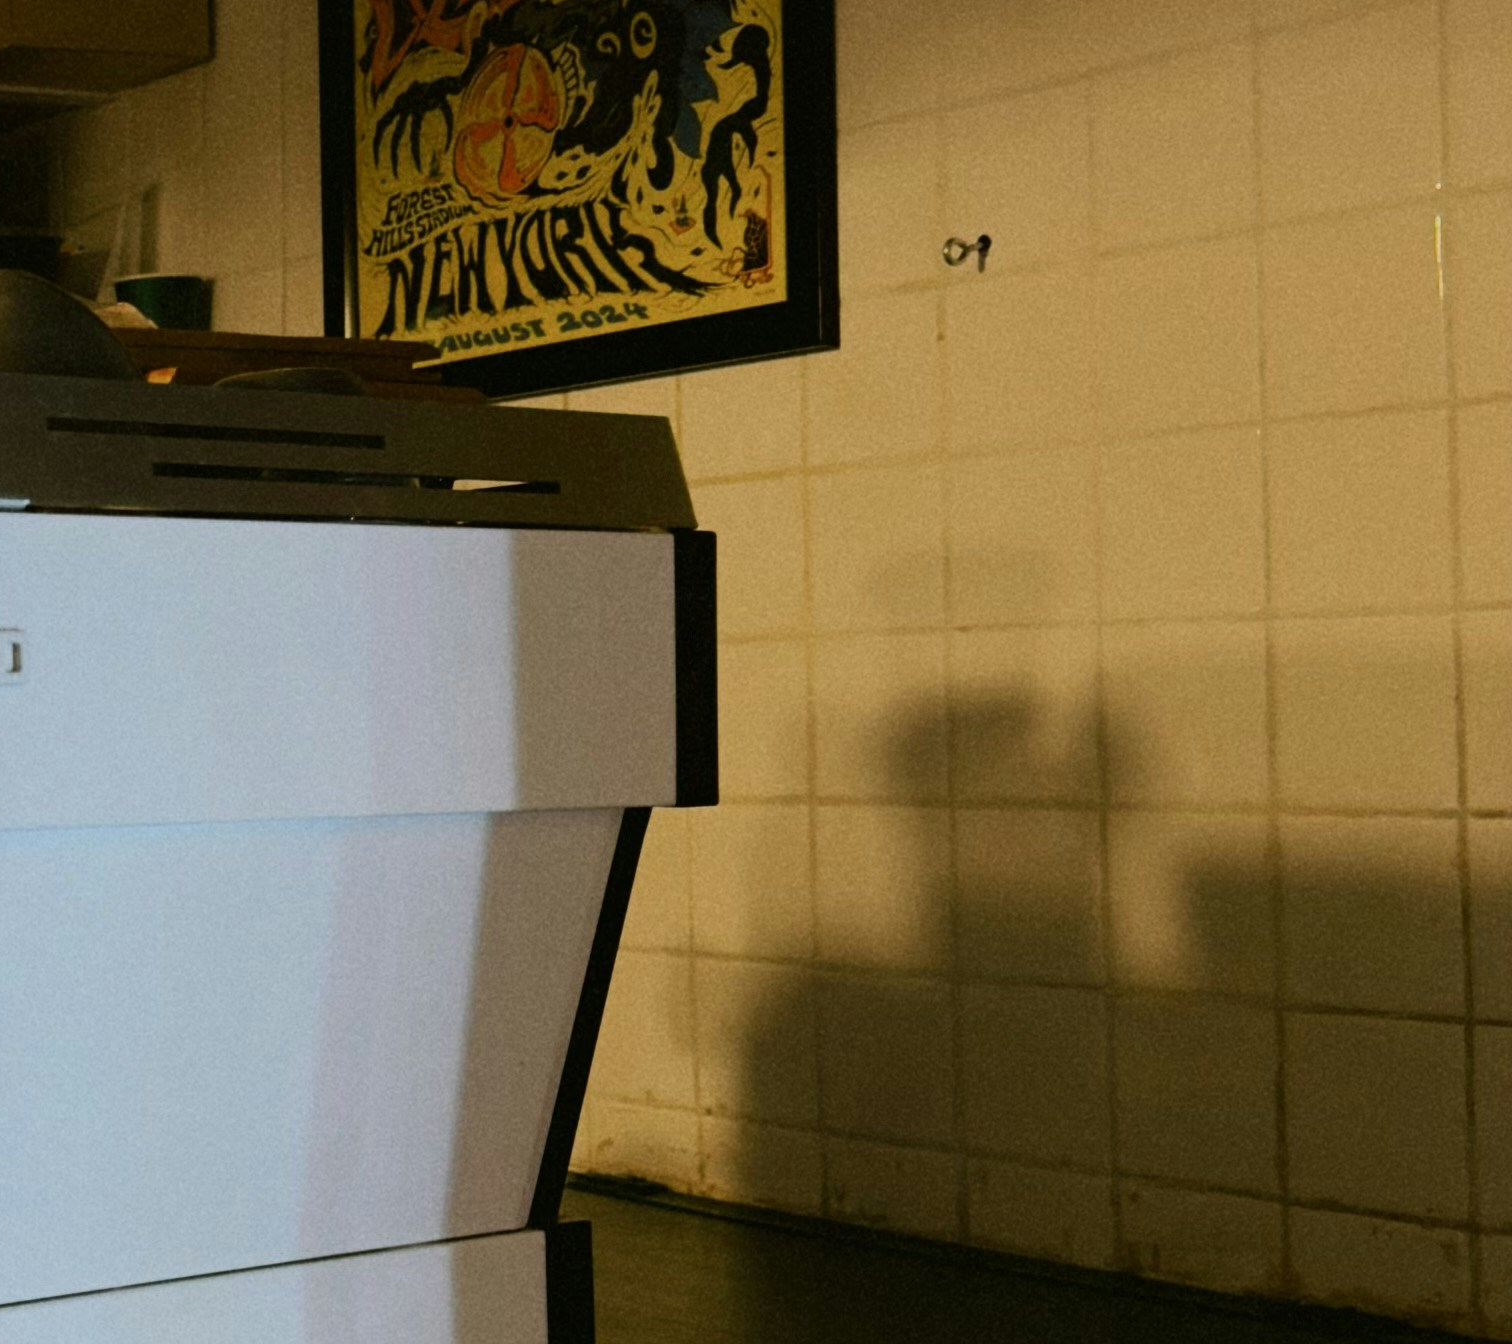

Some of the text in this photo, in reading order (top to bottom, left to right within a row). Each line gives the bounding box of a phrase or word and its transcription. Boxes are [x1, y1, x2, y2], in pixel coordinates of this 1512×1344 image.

[382, 183, 455, 226] FOREST
[364, 203, 480, 257] HILLS STADIUM
[439, 303, 650, 352] AUGUST 2024
